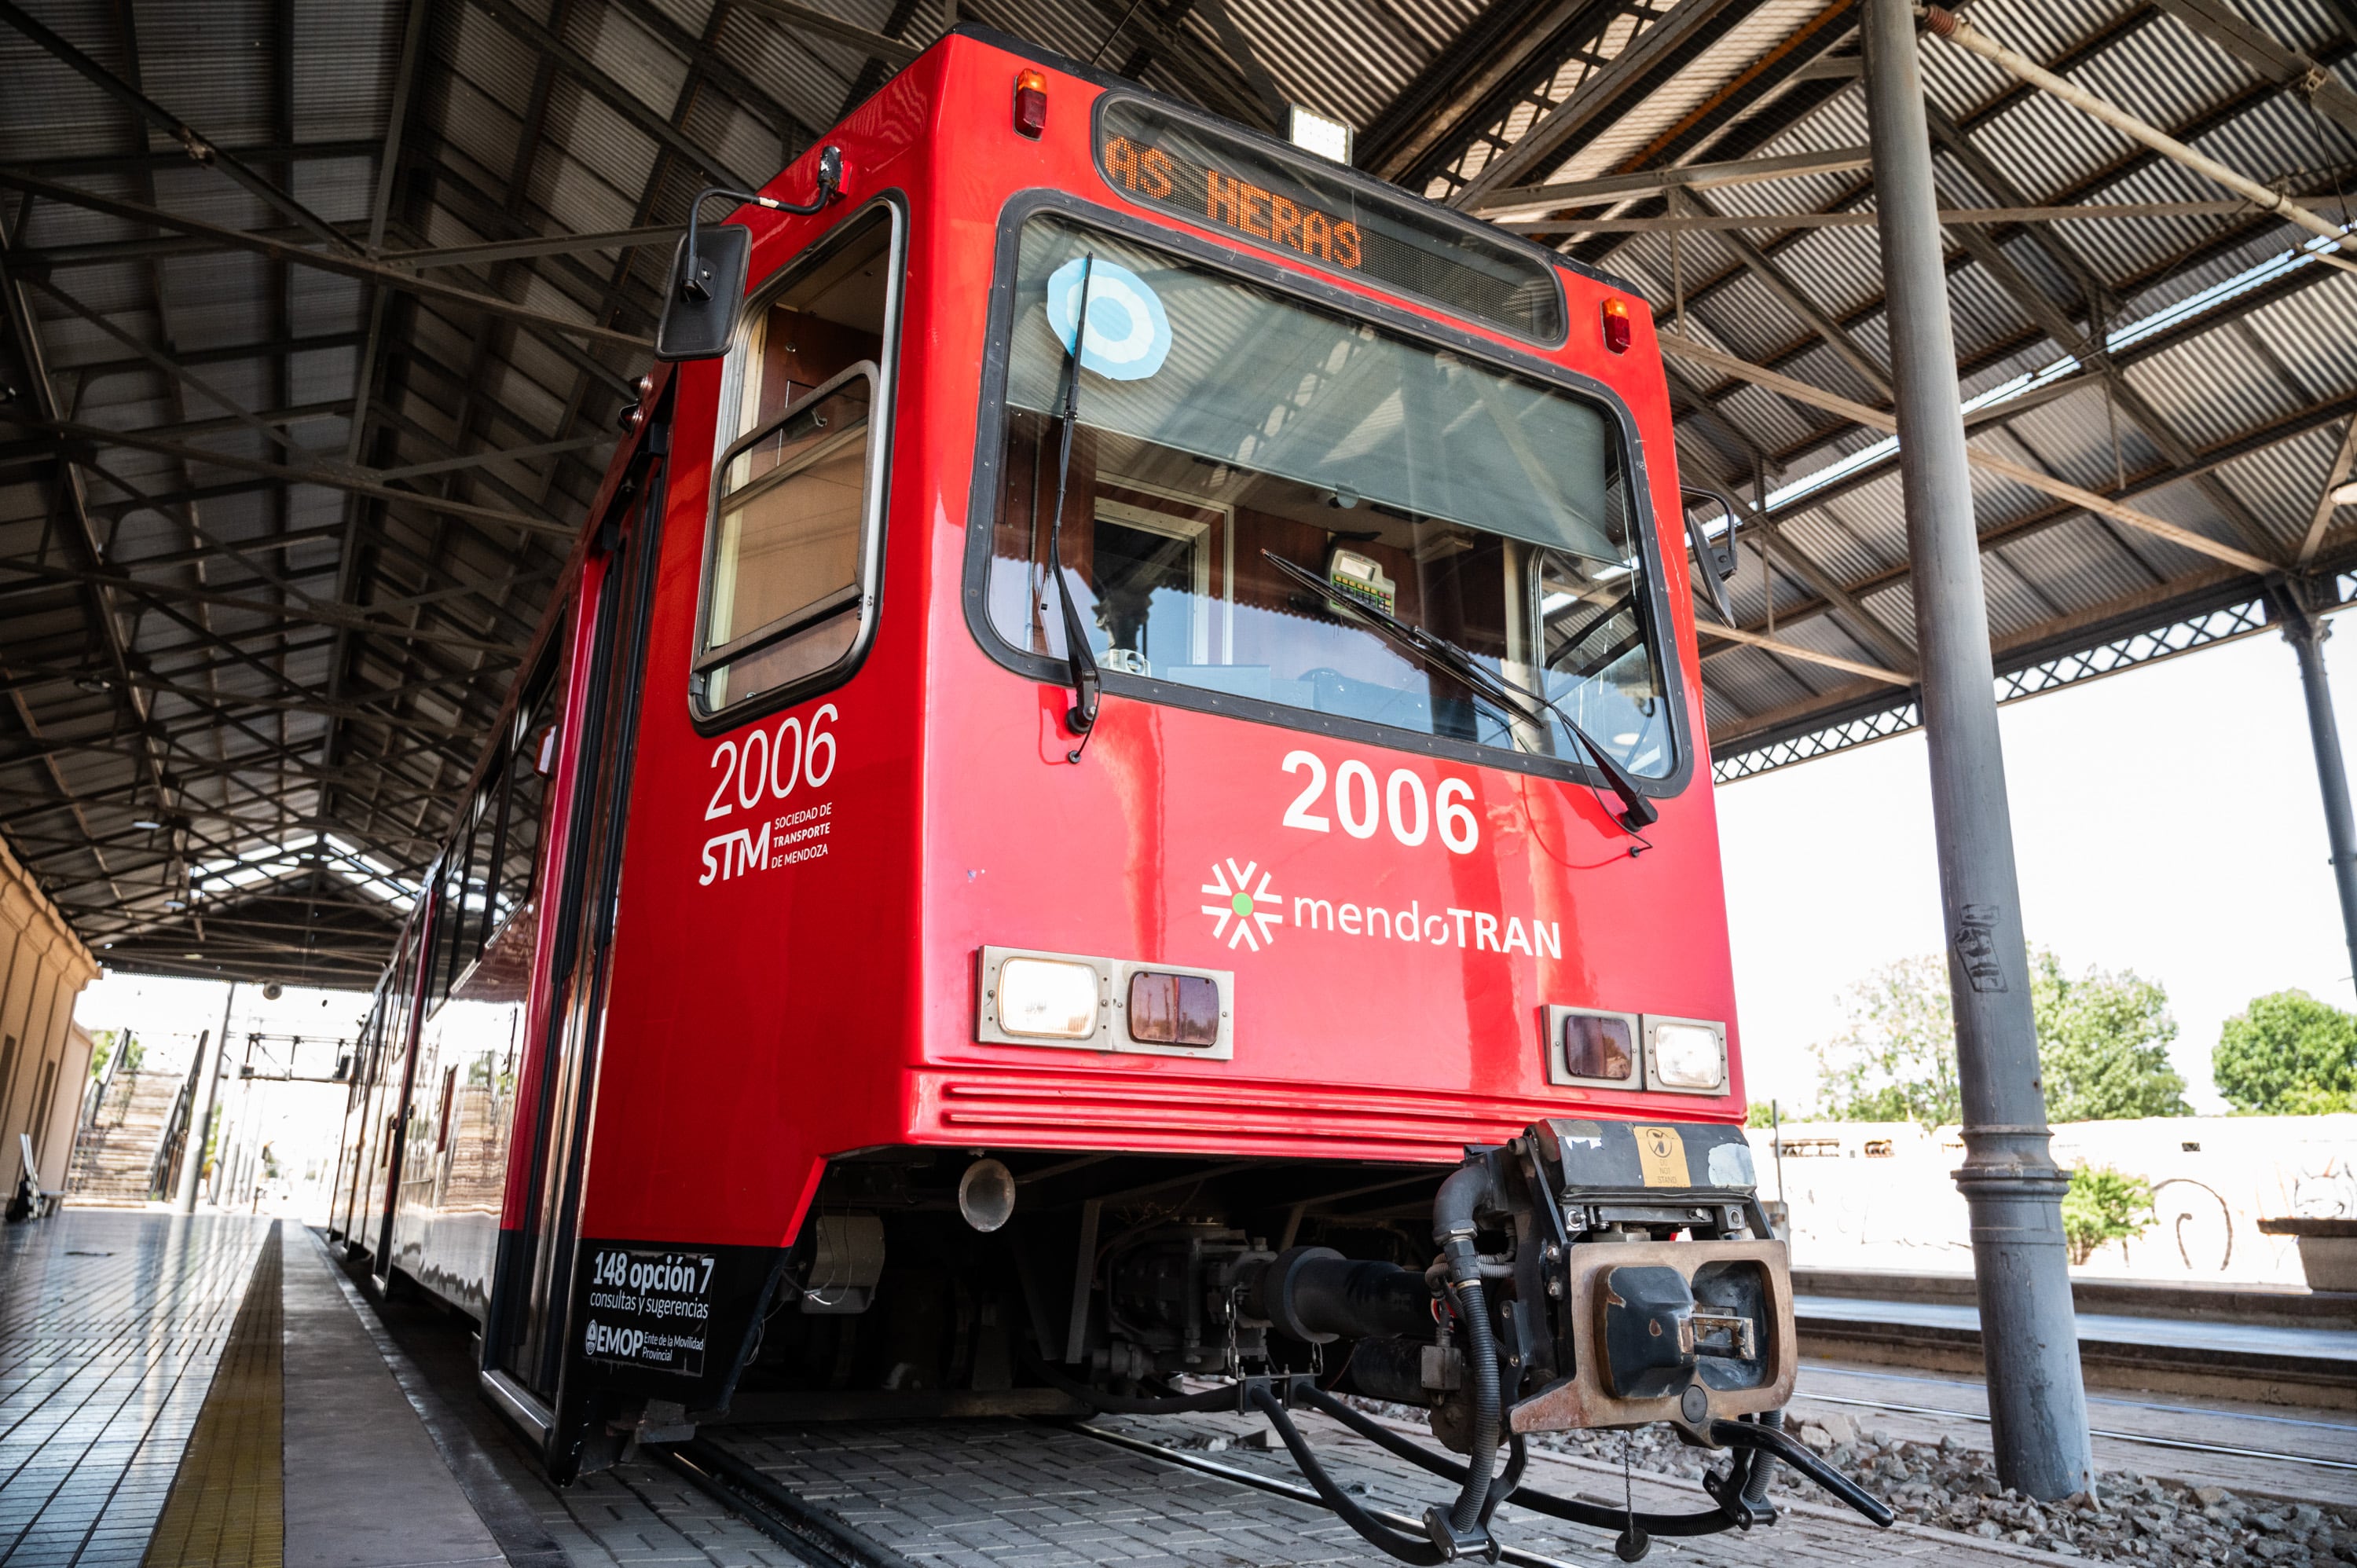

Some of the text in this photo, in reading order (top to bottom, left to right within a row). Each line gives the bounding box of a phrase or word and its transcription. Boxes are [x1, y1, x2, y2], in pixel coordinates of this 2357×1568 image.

[1105, 136, 1362, 269] AS HERAS
[705, 703, 838, 822] 2006
[775, 802, 832, 830] SOCIEDAD DE
[1281, 749, 1479, 855] 2006
[773, 822, 831, 848] TRANSPORTE
[698, 821, 771, 886] STM
[772, 844, 829, 869] DE MENDOZA
[1293, 896, 1562, 959] mendoTRAN
[593, 1251, 715, 1295] 148 opción 7
[590, 1289, 709, 1319] consultas y sugerencias
[596, 1325, 643, 1357] EMOP
[642, 1346, 673, 1361] Provincial
[643, 1332, 704, 1350] Ente de la Movilidad
